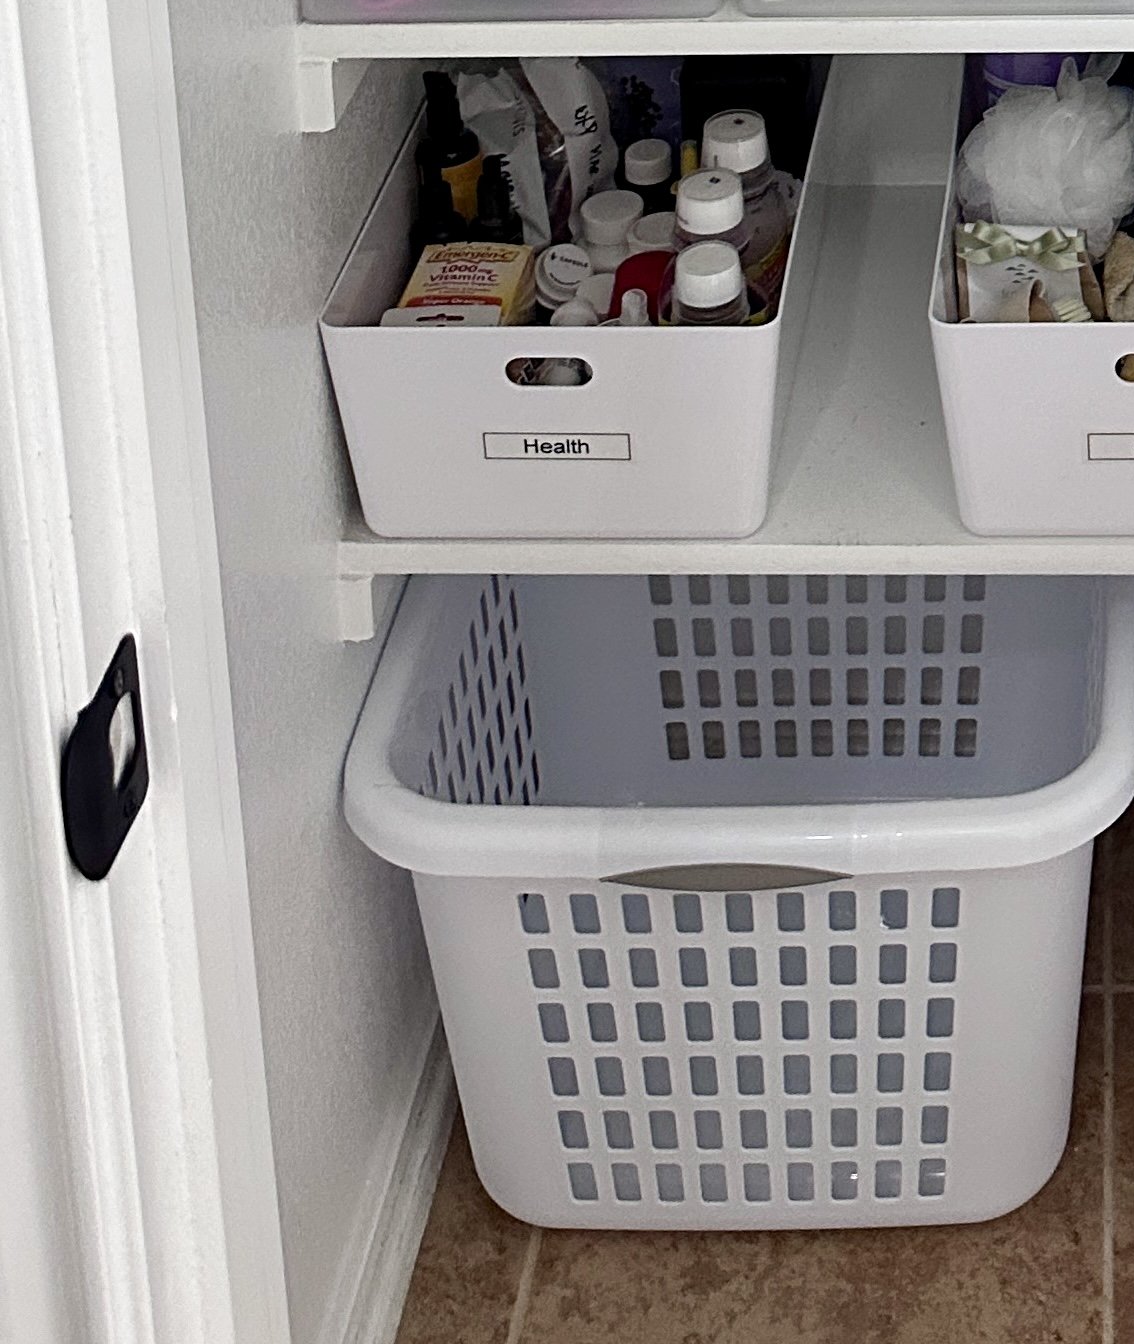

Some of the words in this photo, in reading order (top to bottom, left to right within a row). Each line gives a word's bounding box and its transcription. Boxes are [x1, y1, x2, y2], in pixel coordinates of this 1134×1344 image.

[430, 273, 486, 282] Vitamin
[486, 273, 499, 282] C
[524, 439, 589, 454] Health
